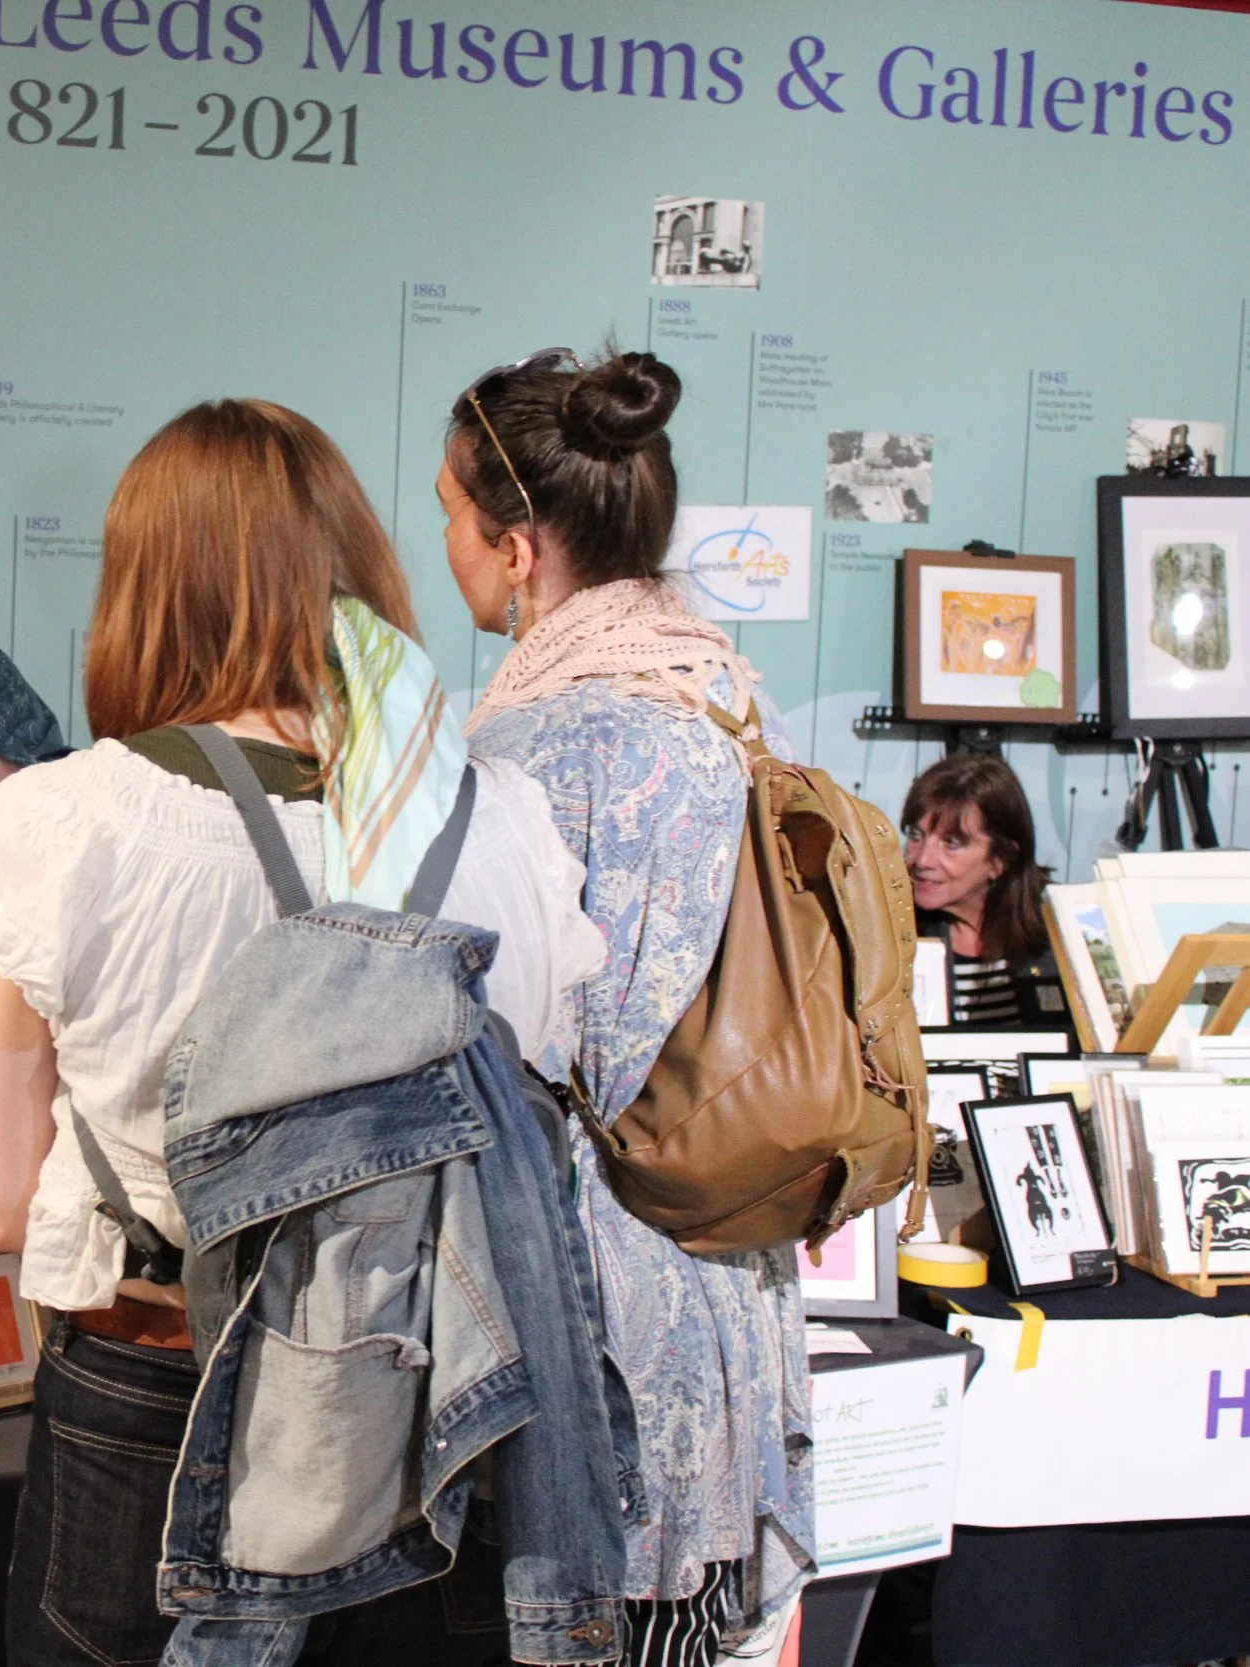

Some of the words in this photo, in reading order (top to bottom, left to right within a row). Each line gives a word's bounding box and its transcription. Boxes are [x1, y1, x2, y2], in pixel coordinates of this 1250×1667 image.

[302, 0, 744, 105] Museums
[777, 35, 846, 114] &
[878, 46, 1235, 146] Galleries
[413, 284, 447, 298] 1863
[437, 301, 482, 315] Exchange
[659, 299, 691, 313] 1888
[761, 334, 793, 348] 1908
[1039, 371, 1068, 384] 1945
[10, 400, 74, 412] Philosophical
[29, 414, 73, 427] officially
[25, 515, 61, 531] 1823
[830, 533, 861, 547] 1923
[738, 548, 790, 579] Arts
[855, 563, 881, 574] public
[746, 576, 782, 589] Society
